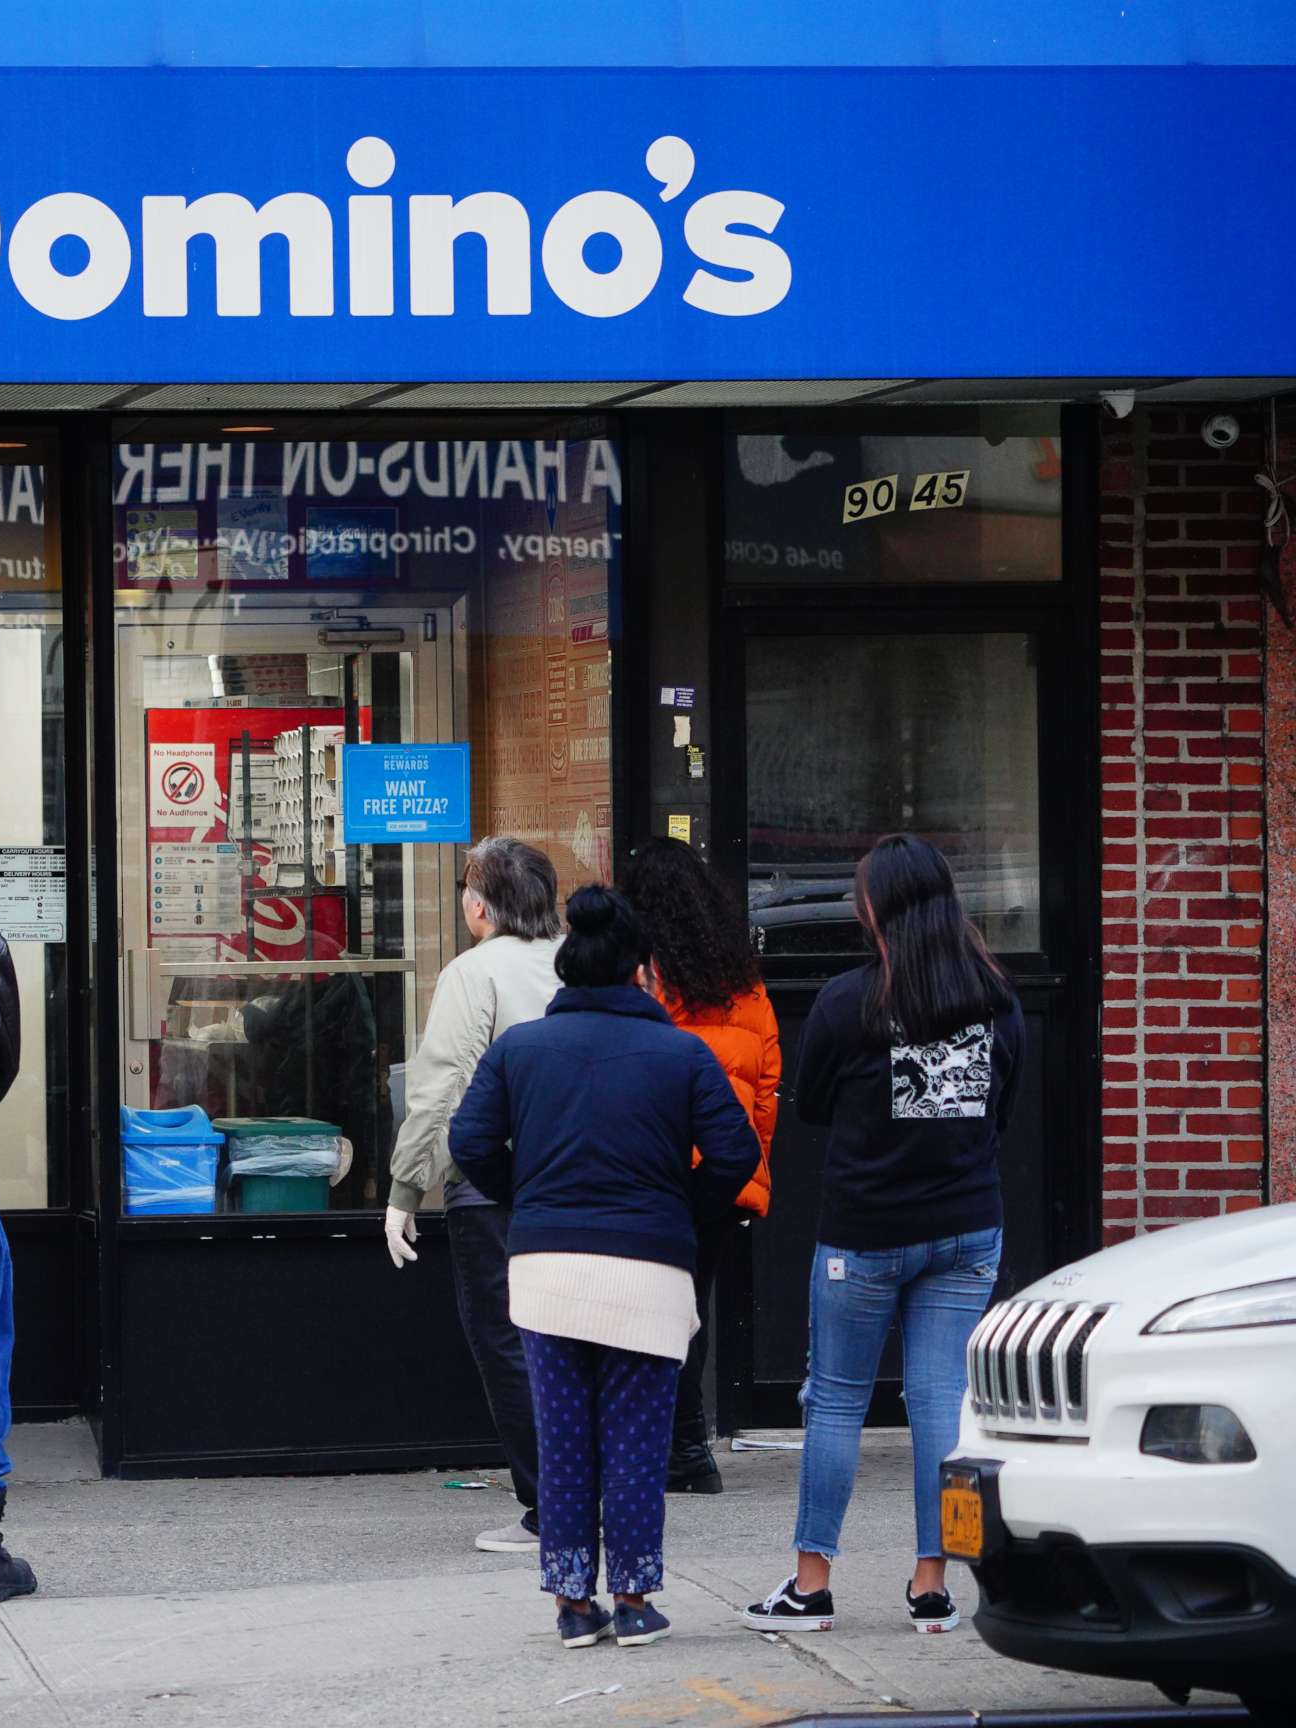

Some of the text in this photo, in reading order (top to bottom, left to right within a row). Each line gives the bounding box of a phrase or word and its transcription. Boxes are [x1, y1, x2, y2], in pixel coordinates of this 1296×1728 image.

[847, 473, 965, 518] 90 45
[167, 750, 213, 758] Headphones
[384, 759, 429, 771] REWARDS
[385, 780, 426, 797] WANT
[156, 809, 208, 817] No Audifonos
[364, 798, 449, 816] FREE PIZZA?
